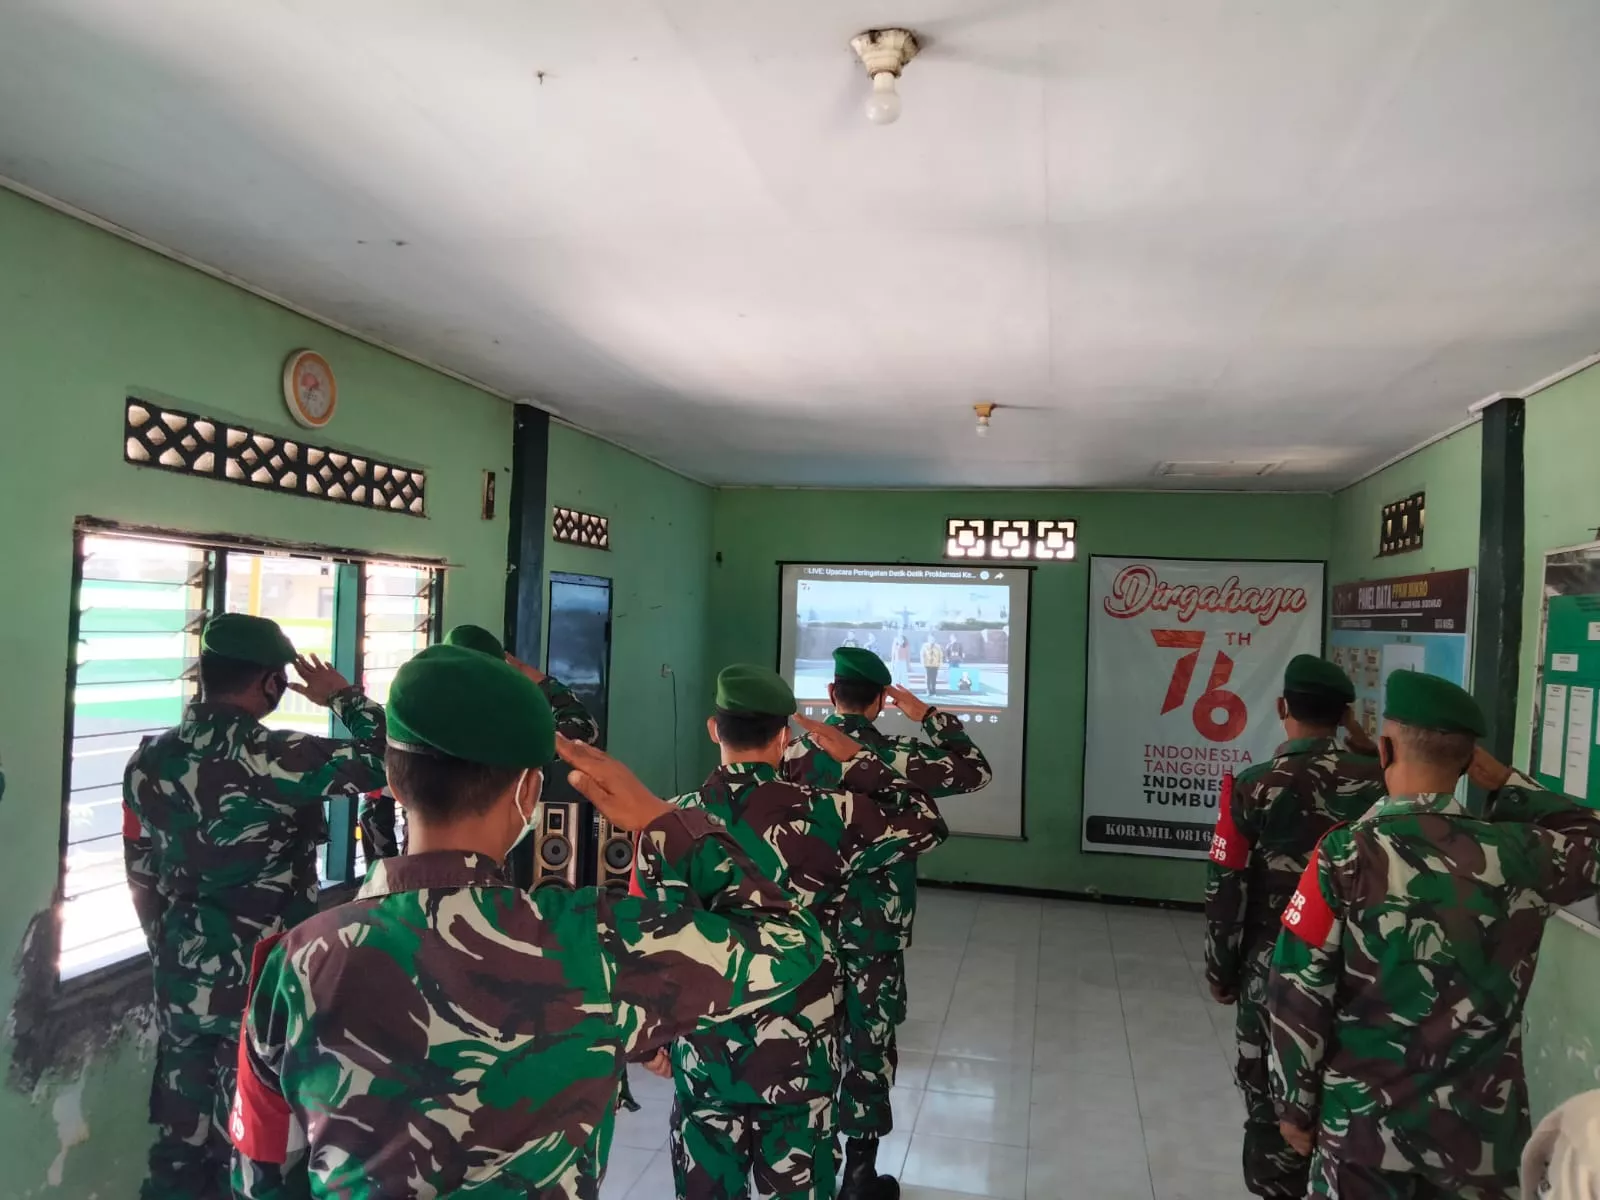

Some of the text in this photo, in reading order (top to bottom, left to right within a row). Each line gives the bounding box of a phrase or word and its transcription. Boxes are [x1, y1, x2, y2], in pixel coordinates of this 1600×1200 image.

[826, 568, 852, 577] Upacara
[854, 568, 887, 578] Peringatan
[924, 570, 961, 579] Proklamasi
[1104, 564, 1306, 626] Dirgahayu
[1376, 584, 1392, 609] DATA
[1150, 628, 1252, 742] 76 TH
[1143, 744, 1253, 764] INDONESIA
[1143, 759, 1234, 776] TANGGUH
[1143, 789, 1220, 808] TUMBU
[1105, 823, 1173, 840] KORAMIL
[1209, 845, 1227, 861] -19
